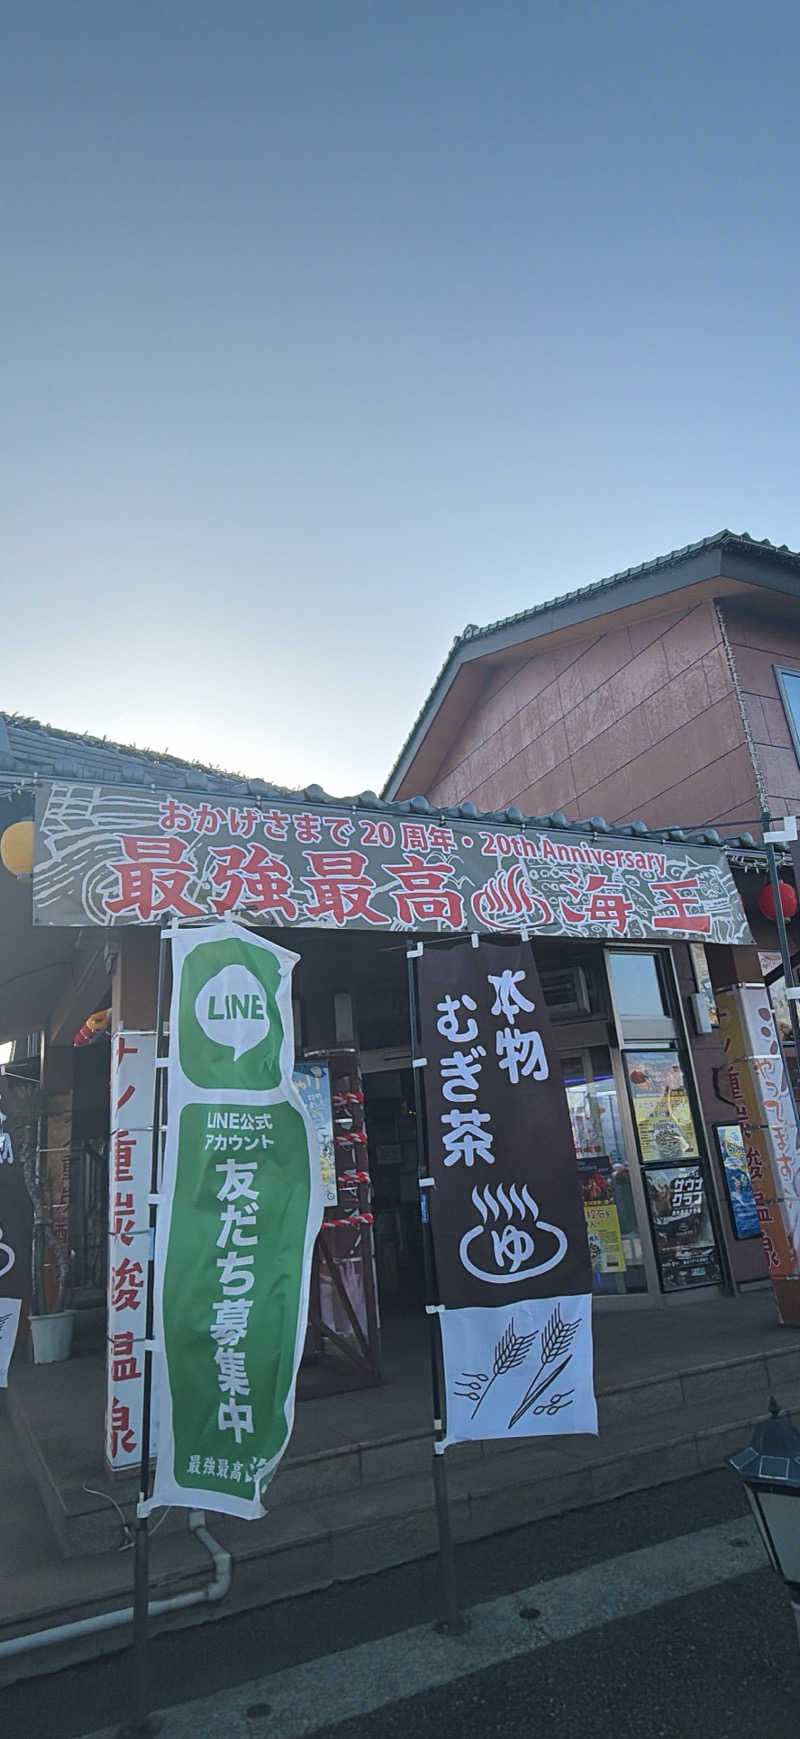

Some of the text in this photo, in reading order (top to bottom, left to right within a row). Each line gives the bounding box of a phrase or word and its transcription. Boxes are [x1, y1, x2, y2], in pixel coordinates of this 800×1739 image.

[541, 838, 667, 876] Anniversary
[103, 833, 712, 934] 最強最高 海王
[207, 994, 265, 1021] LINE
[487, 969, 550, 1084] 本物
[437, 994, 495, 1167] むぎ茶
[204, 1134, 275, 1152] アカウント
[206, 1111, 273, 1131] LINE公式
[491, 1224, 535, 1272] ゆ
[209, 1158, 260, 1444] 友だち募集中
